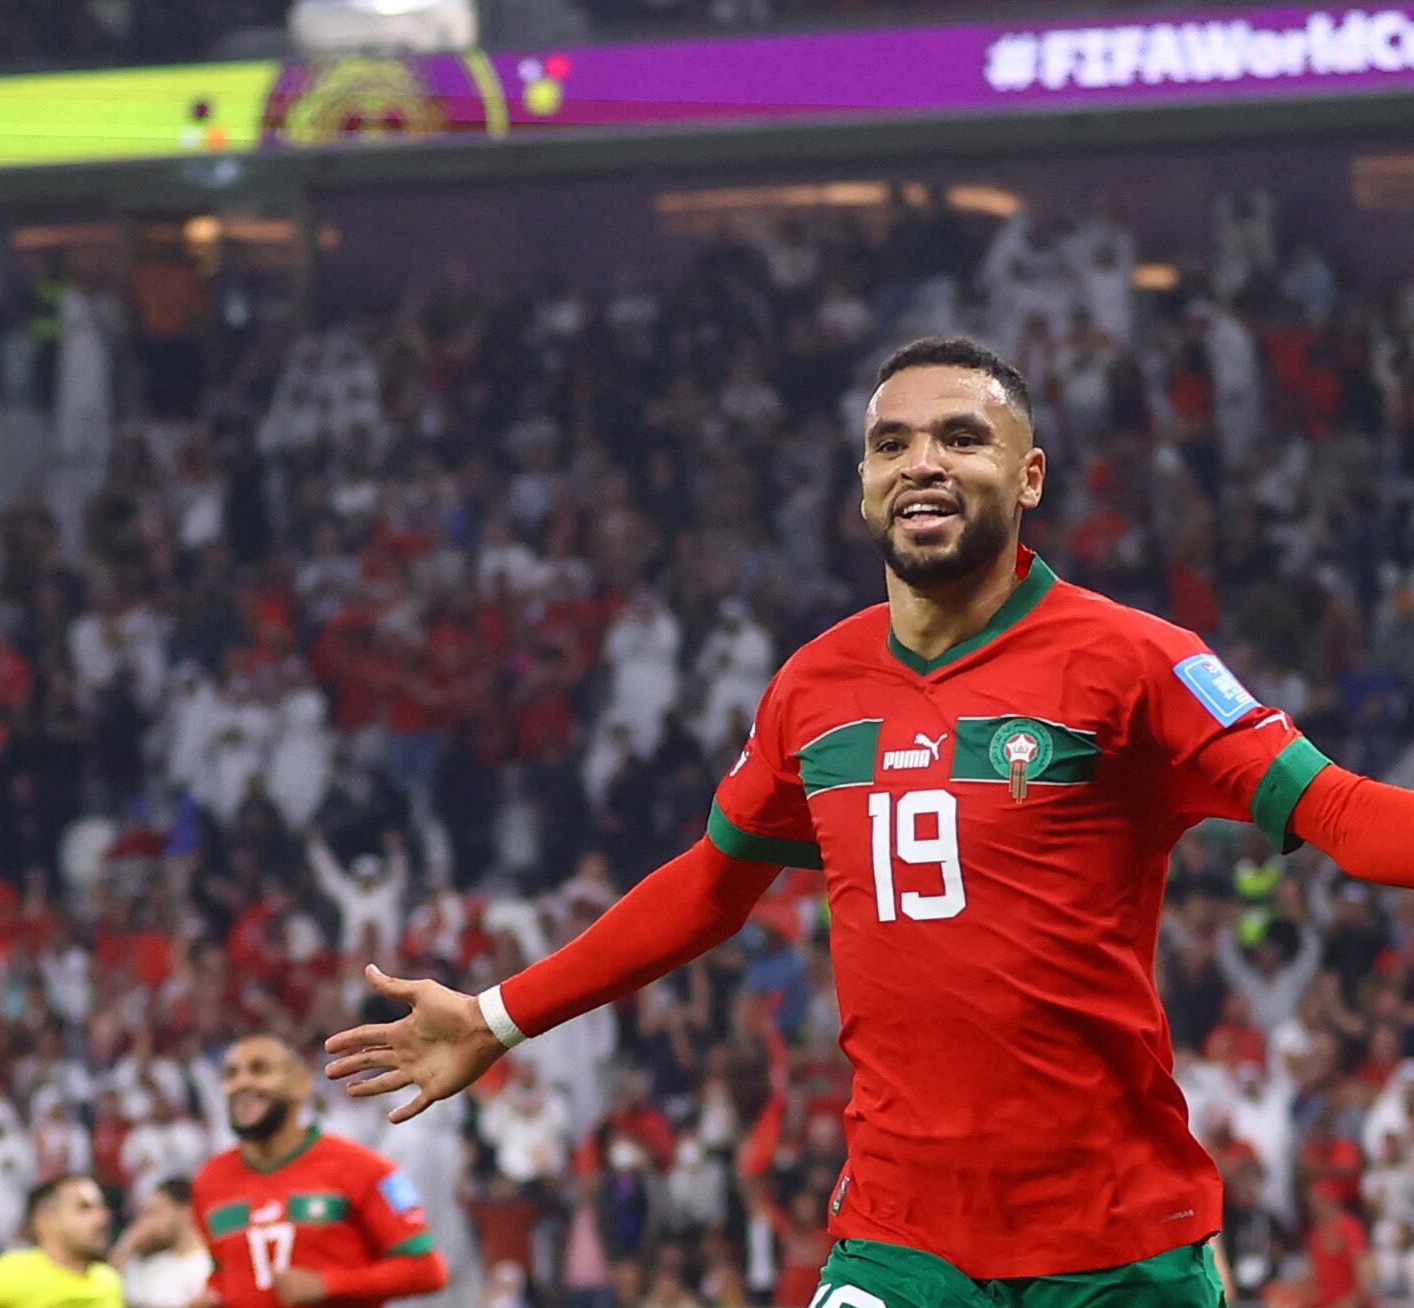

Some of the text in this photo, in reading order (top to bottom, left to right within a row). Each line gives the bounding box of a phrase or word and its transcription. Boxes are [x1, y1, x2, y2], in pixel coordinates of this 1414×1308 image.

[882, 749, 931, 770] PUMA
[868, 789, 967, 922] 19
[246, 1221, 296, 1291] 17
